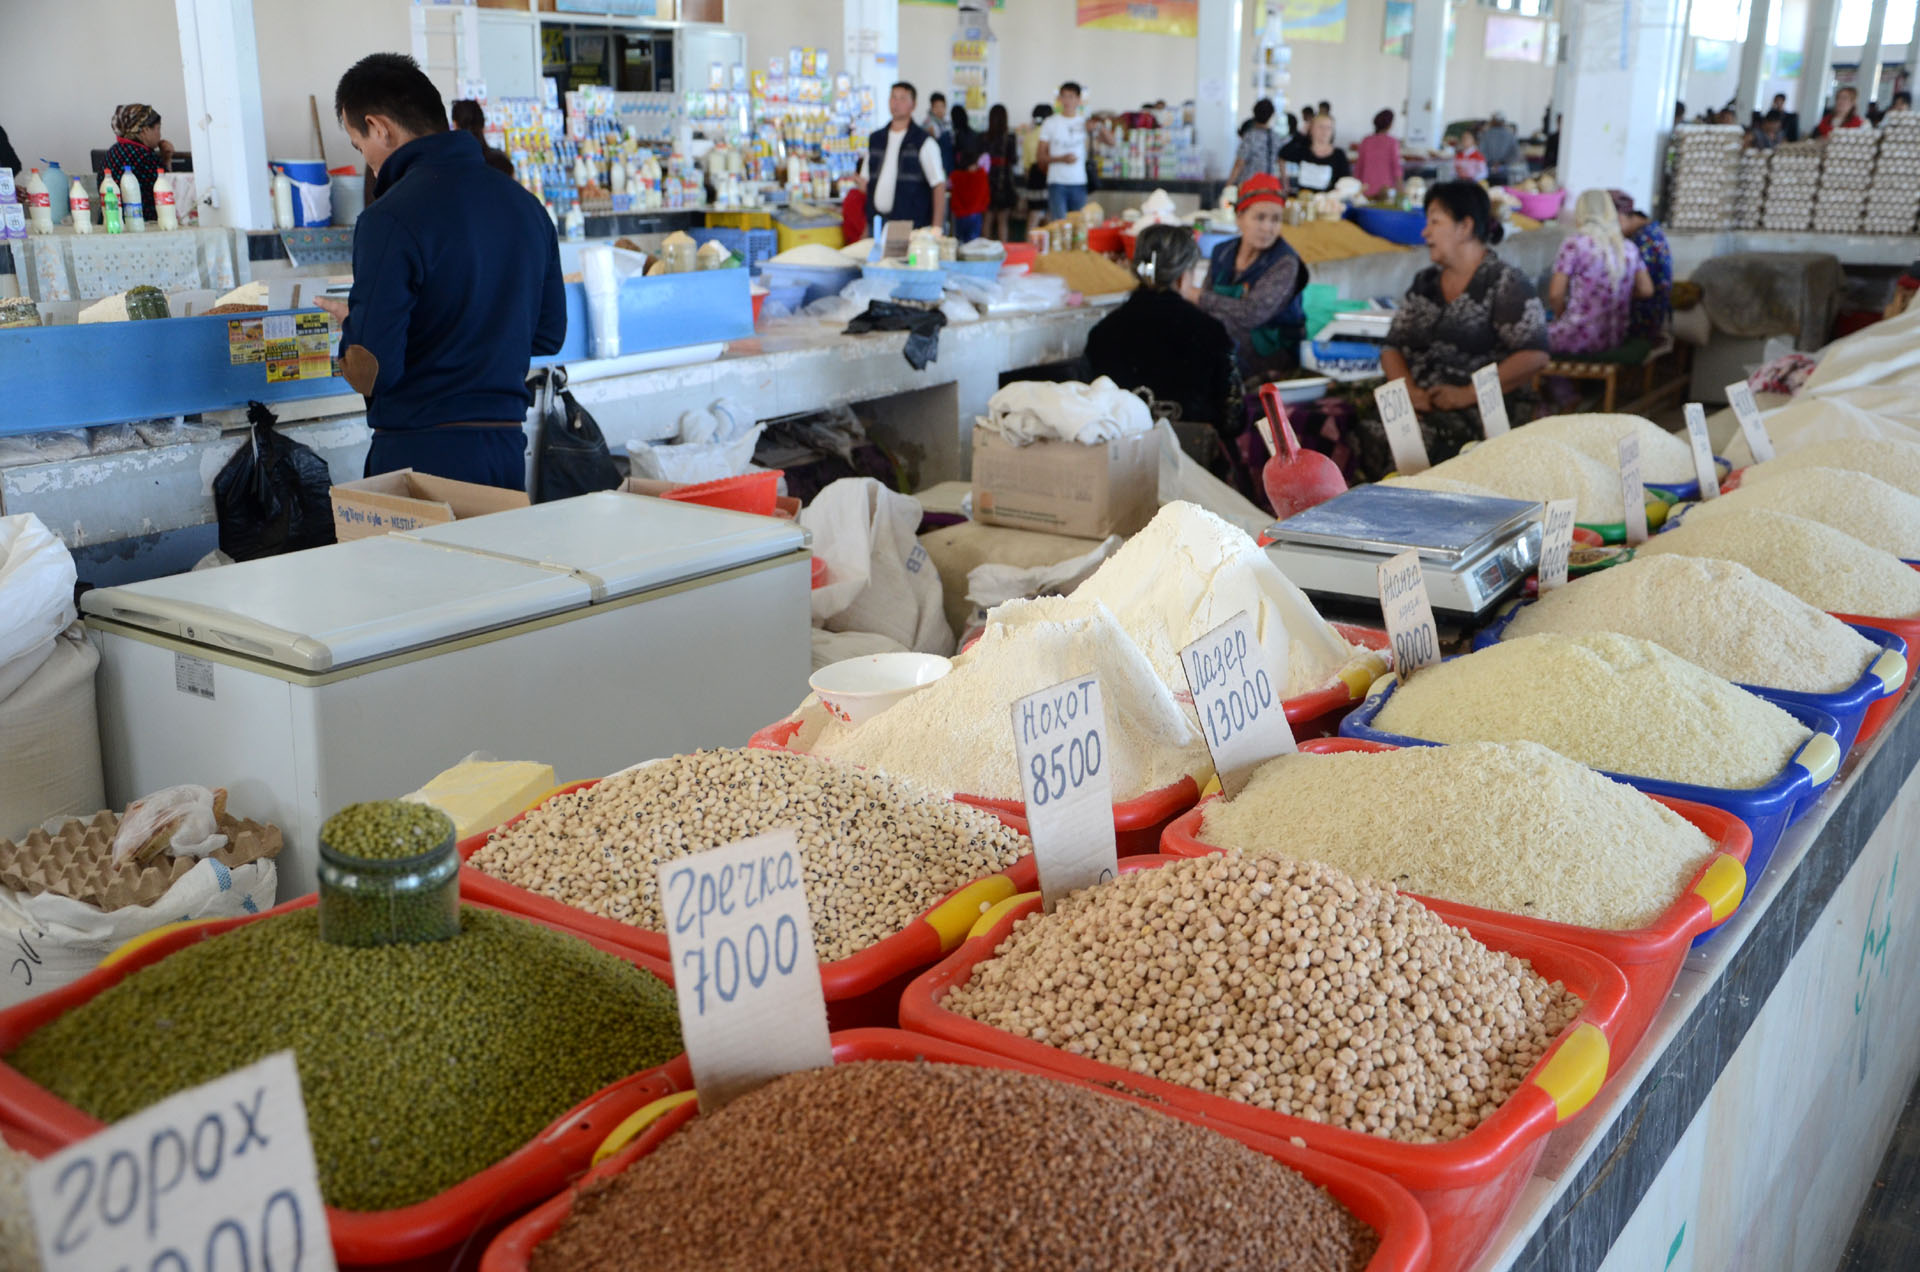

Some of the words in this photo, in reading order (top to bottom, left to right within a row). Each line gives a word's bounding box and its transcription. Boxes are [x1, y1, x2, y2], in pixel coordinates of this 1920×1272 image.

[1192, 629, 1247, 696] Лазер
[1396, 623, 1433, 681] 8000
[1206, 669, 1272, 748] 13000
[1030, 729, 1101, 806] 8500
[682, 913, 799, 1017] 7000
